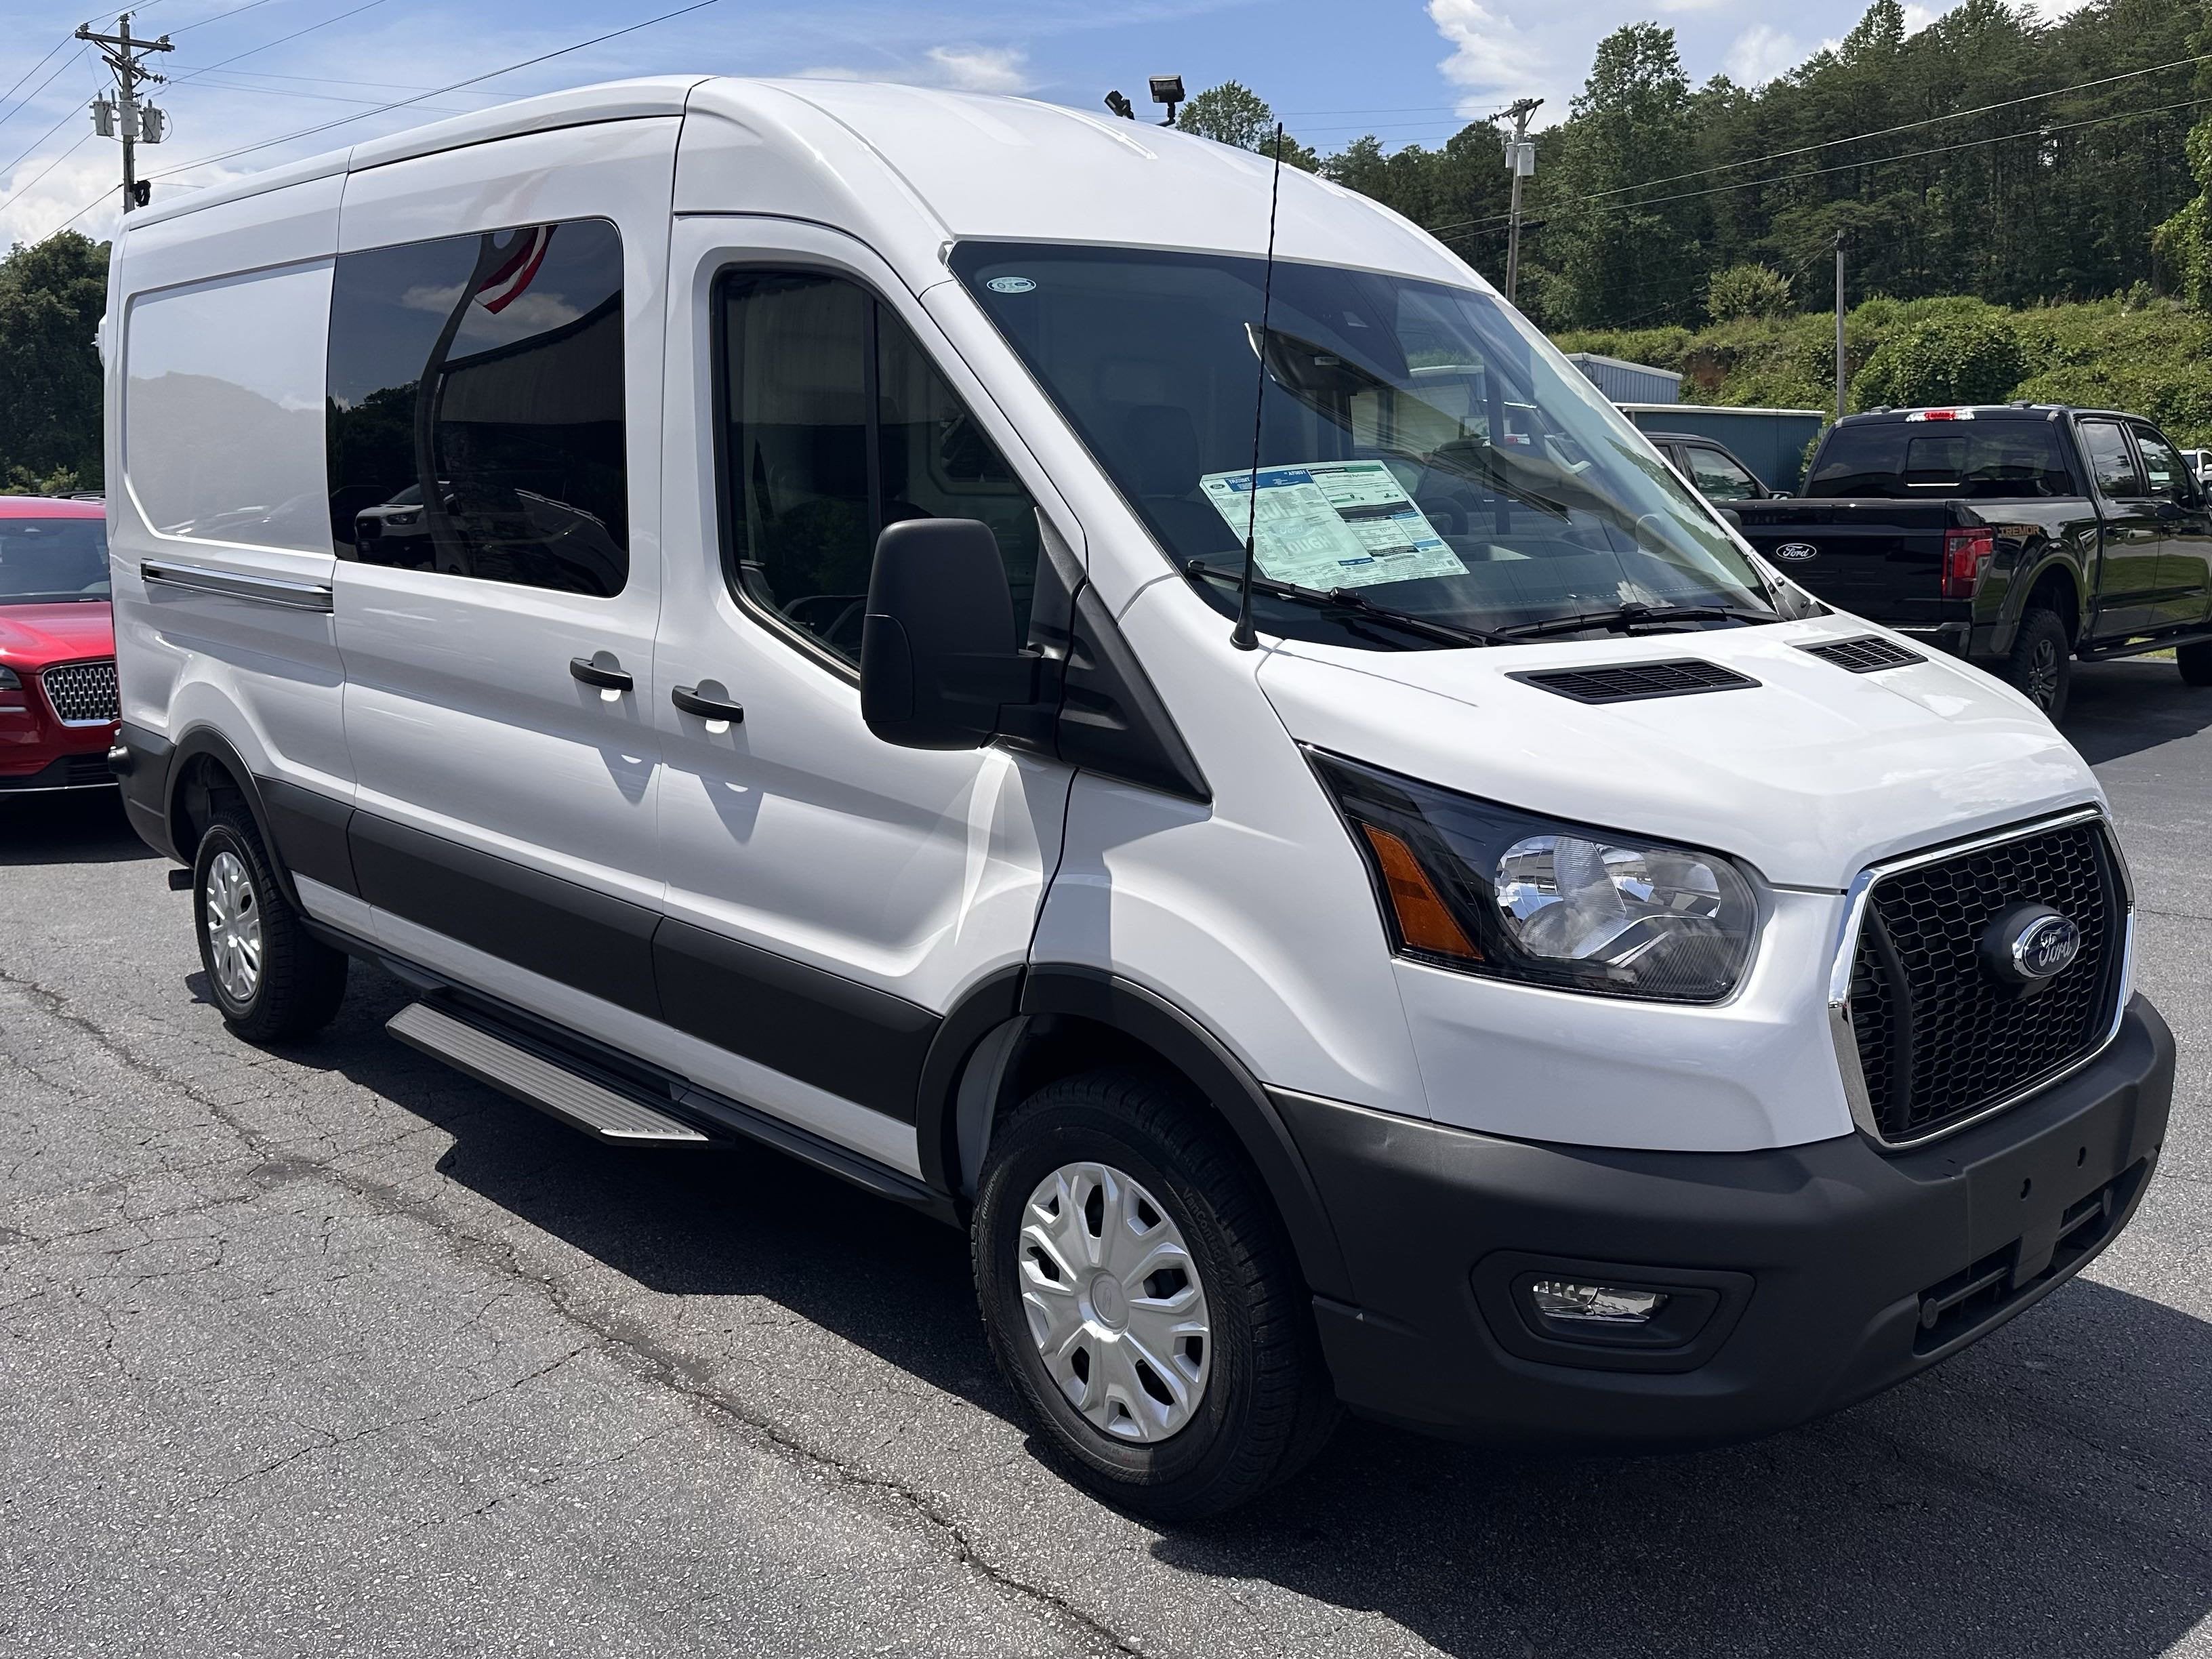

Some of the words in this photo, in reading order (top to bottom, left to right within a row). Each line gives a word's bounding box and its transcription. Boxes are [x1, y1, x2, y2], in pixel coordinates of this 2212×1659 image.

[1999, 525, 2039, 536] TREMOR
[1783, 545, 1809, 557] Ford
[2039, 930, 2072, 967] Ford
